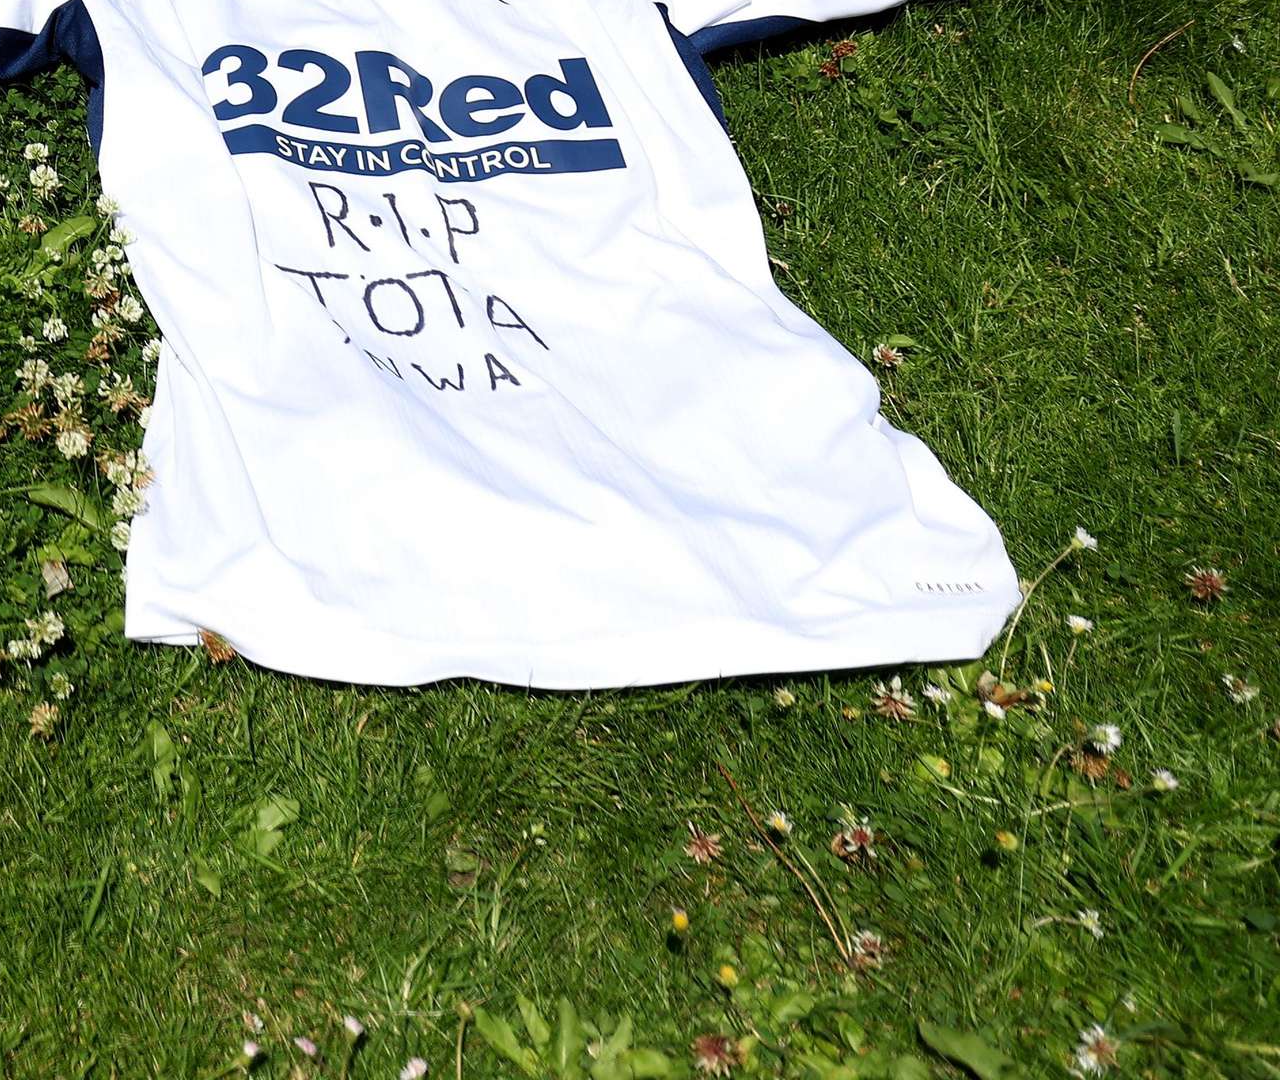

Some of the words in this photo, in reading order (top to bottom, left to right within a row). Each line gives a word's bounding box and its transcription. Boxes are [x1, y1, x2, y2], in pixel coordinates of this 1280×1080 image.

[201, 44, 614, 142] 32Red
[275, 135, 348, 167] STAY
[356, 149, 391, 171] IN
[400, 143, 552, 178] CONTROL
